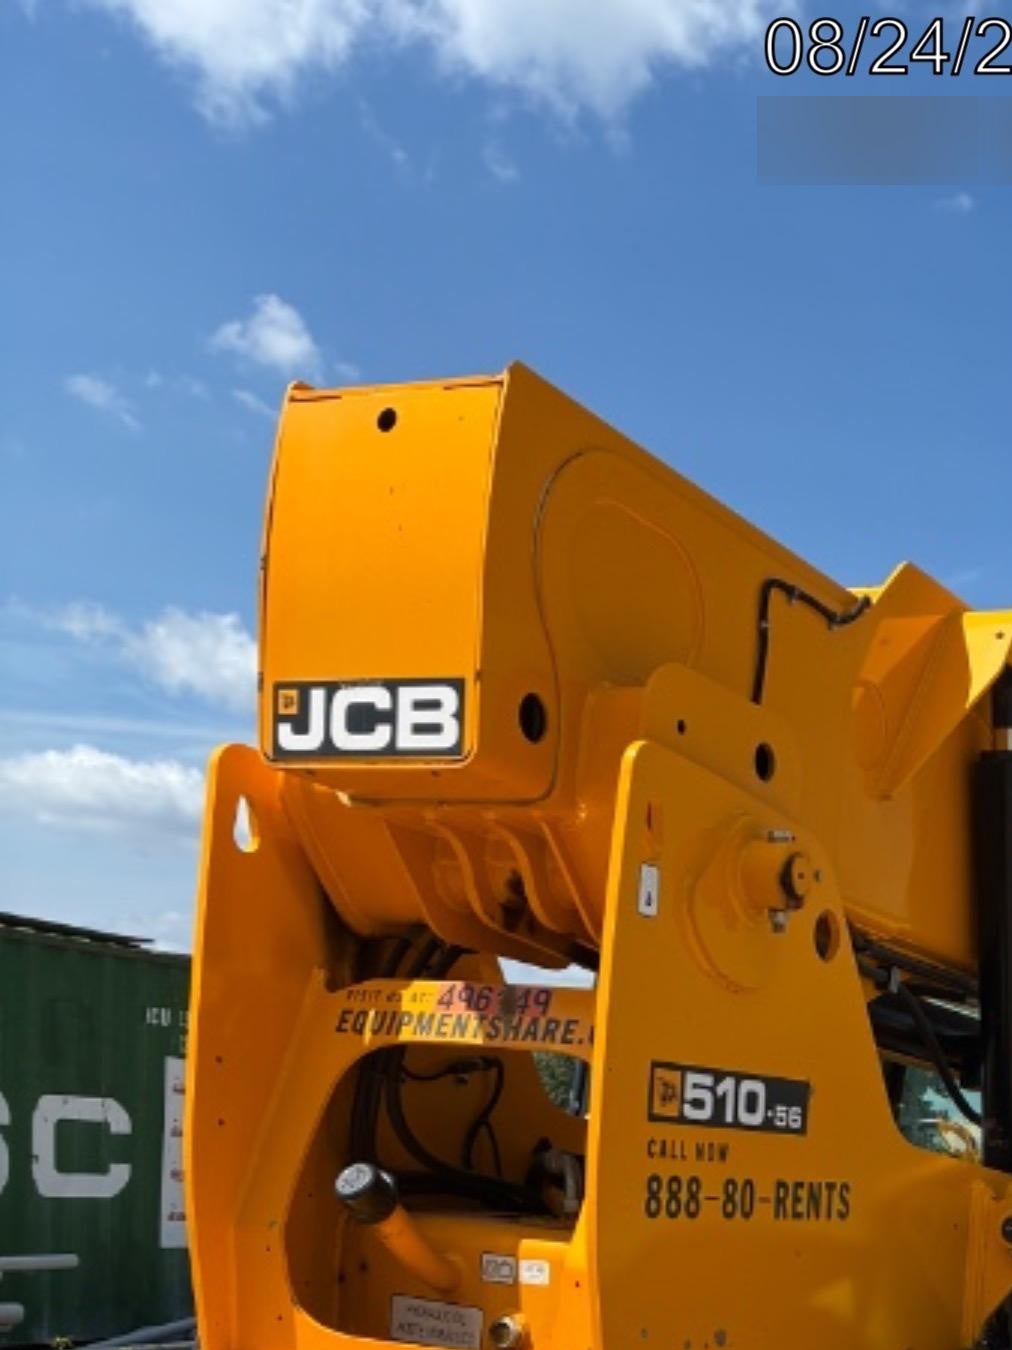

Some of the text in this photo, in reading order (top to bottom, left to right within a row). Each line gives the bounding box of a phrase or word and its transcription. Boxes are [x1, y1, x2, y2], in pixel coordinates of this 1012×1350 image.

[278, 685, 460, 751] JCB
[647, 1137, 730, 1164] CALL NOW
[645, 1173, 851, 1221] 888-80-RENTS
